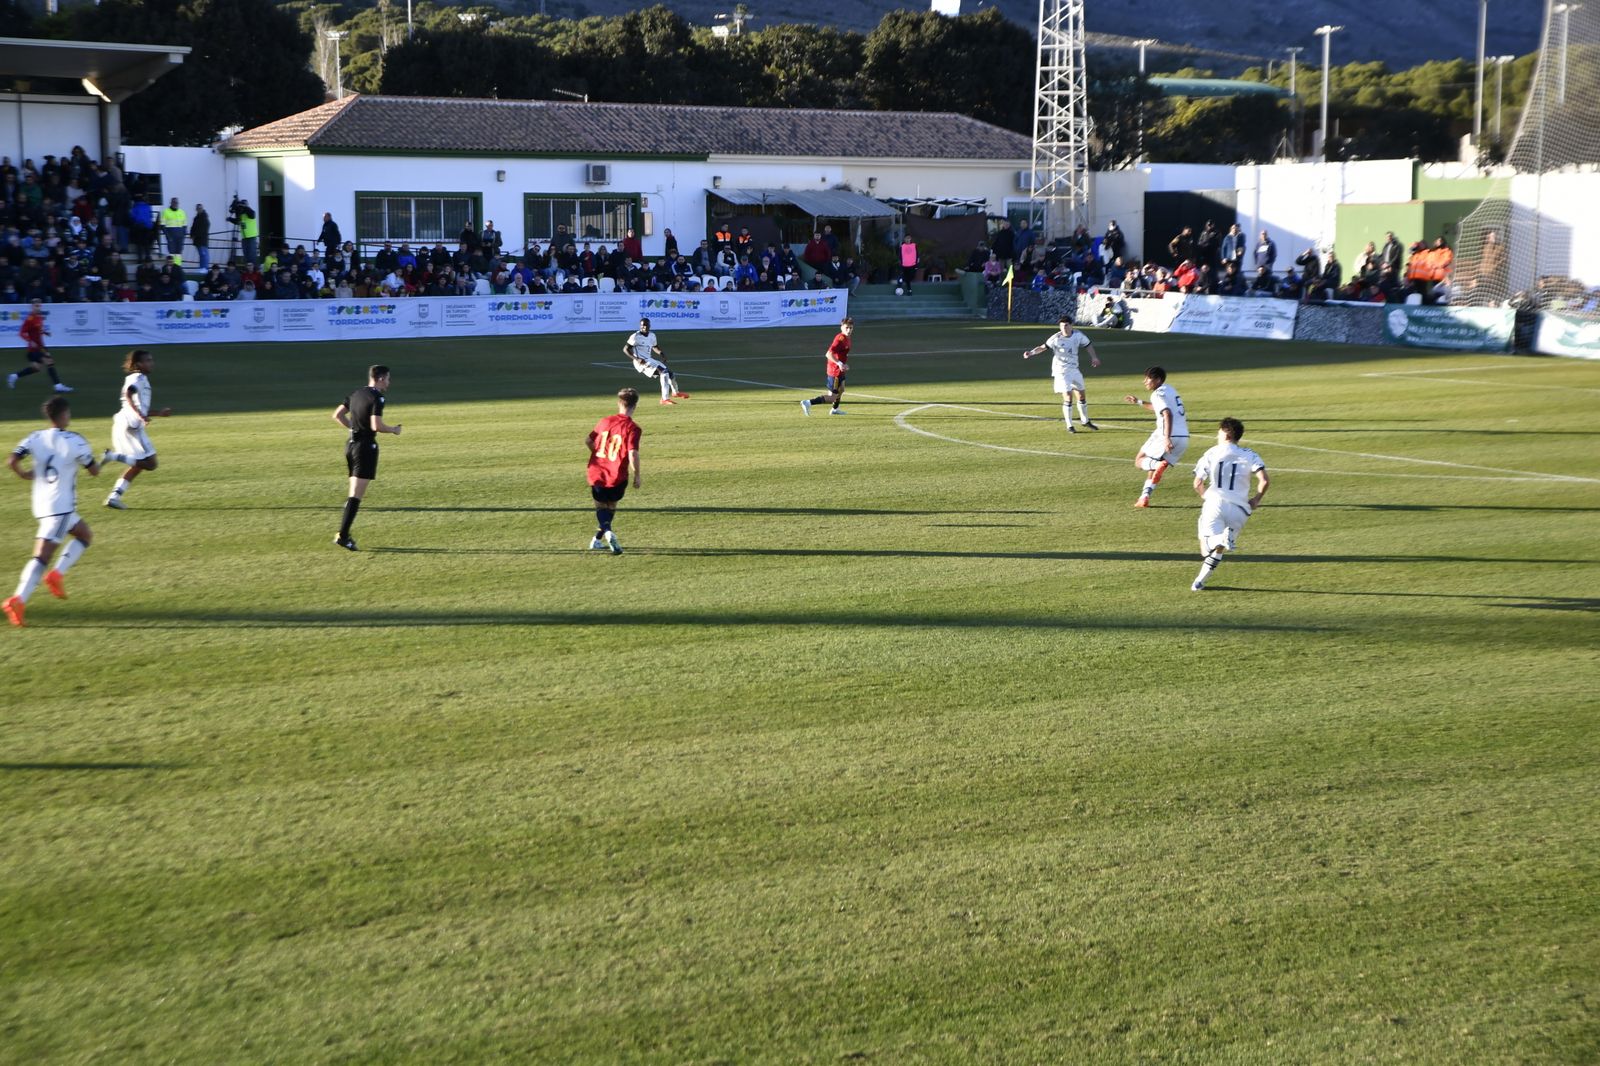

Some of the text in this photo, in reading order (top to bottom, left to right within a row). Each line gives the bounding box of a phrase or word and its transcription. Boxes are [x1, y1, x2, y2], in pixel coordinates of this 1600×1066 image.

[328, 317, 397, 326] TORREMOLINOS
[488, 313, 553, 322] TORREMOLINOS
[639, 311, 701, 319] TORREMOLINOS
[156, 322, 230, 330] TORREMOLINOS
[1175, 395, 1185, 417] 5
[595, 430, 622, 462] 10
[45, 454, 59, 484] 6
[1217, 461, 1238, 491] 11
